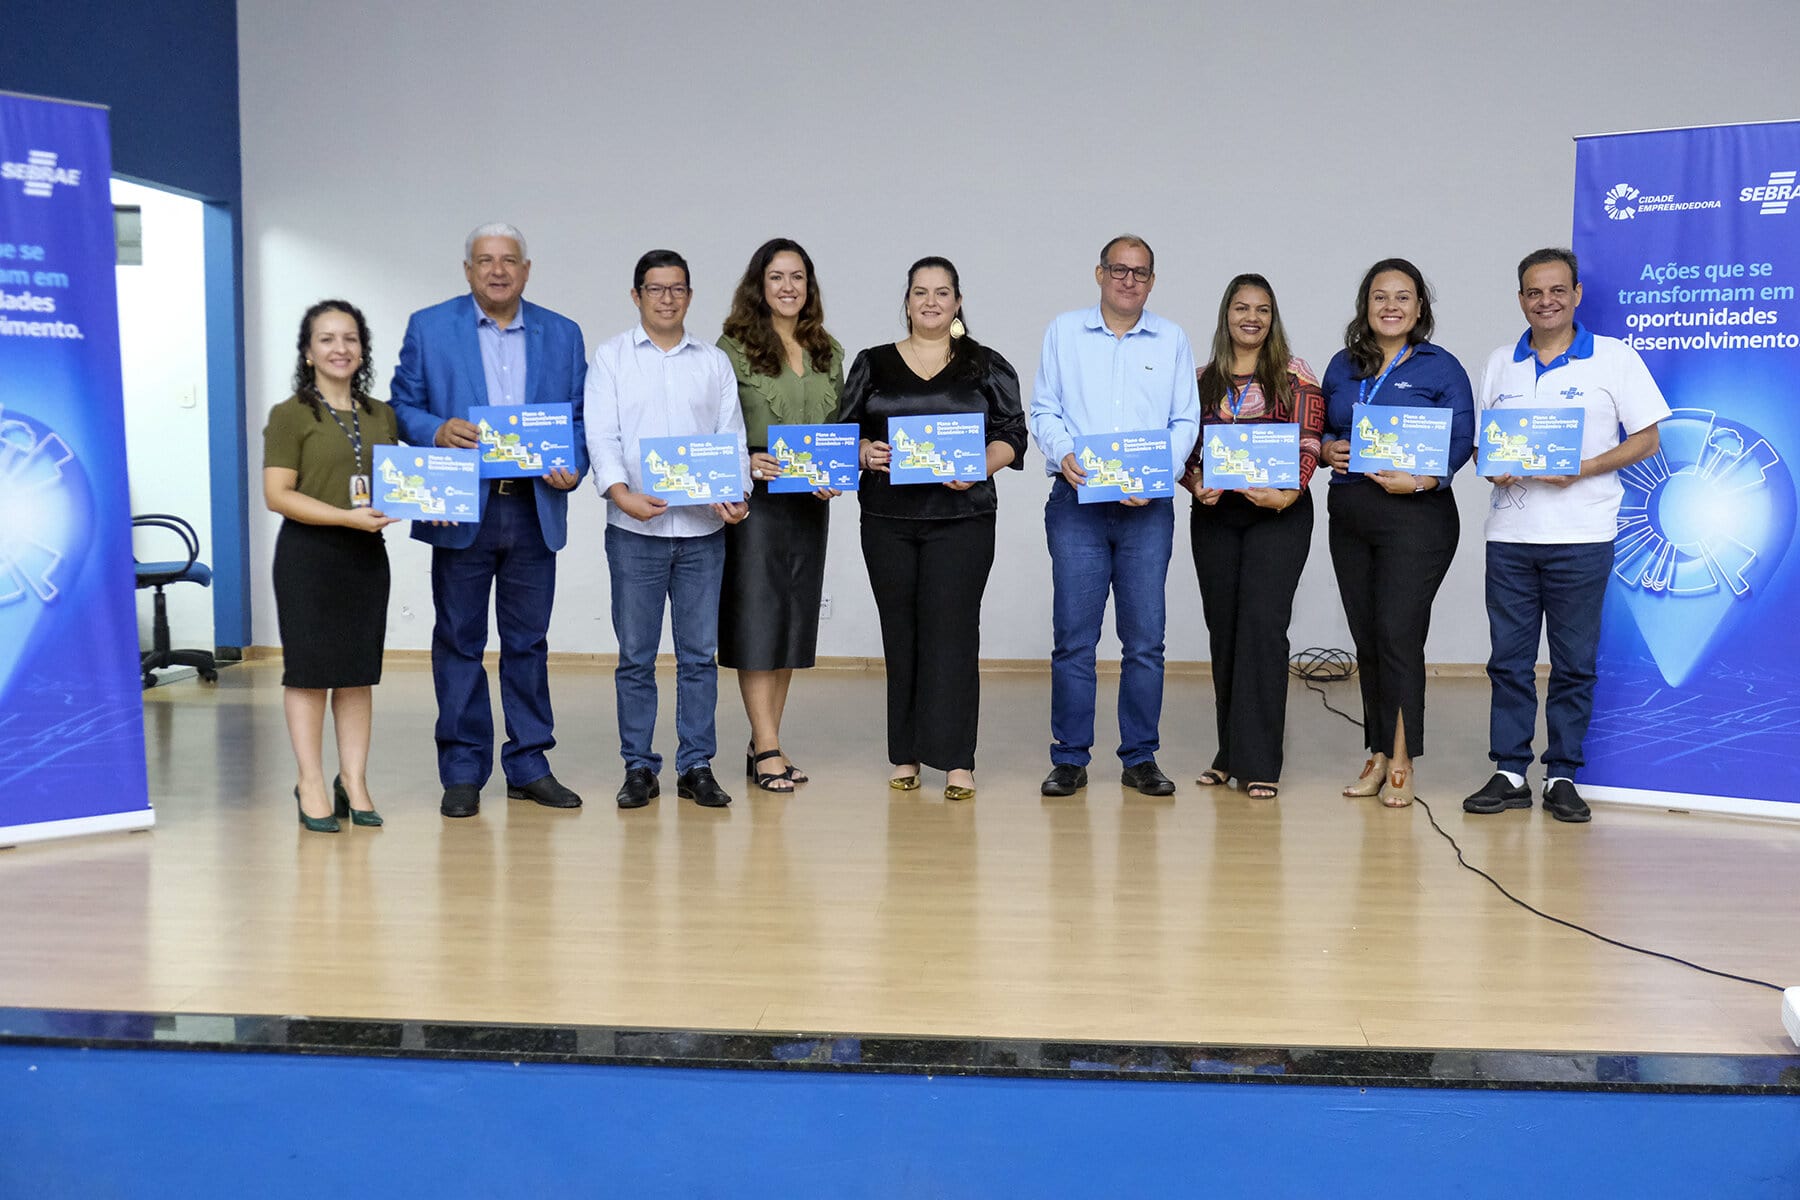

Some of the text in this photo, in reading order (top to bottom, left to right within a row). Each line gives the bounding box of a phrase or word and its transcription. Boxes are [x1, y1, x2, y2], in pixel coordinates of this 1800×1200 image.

[1, 162, 81, 187] SEBRAE
[1638, 194, 1675, 204] CIDADE
[1739, 185, 1800, 202] SEBRA
[1637, 201, 1721, 212] EMPREENDEDORA
[19, 245, 45, 261] se
[33, 271, 69, 289] em
[1640, 262, 1773, 285] Ações que se
[1618, 285, 1794, 305] transformam em
[1626, 307, 1778, 332] oportunidades
[1622, 331, 1800, 351] desenvolvimento
